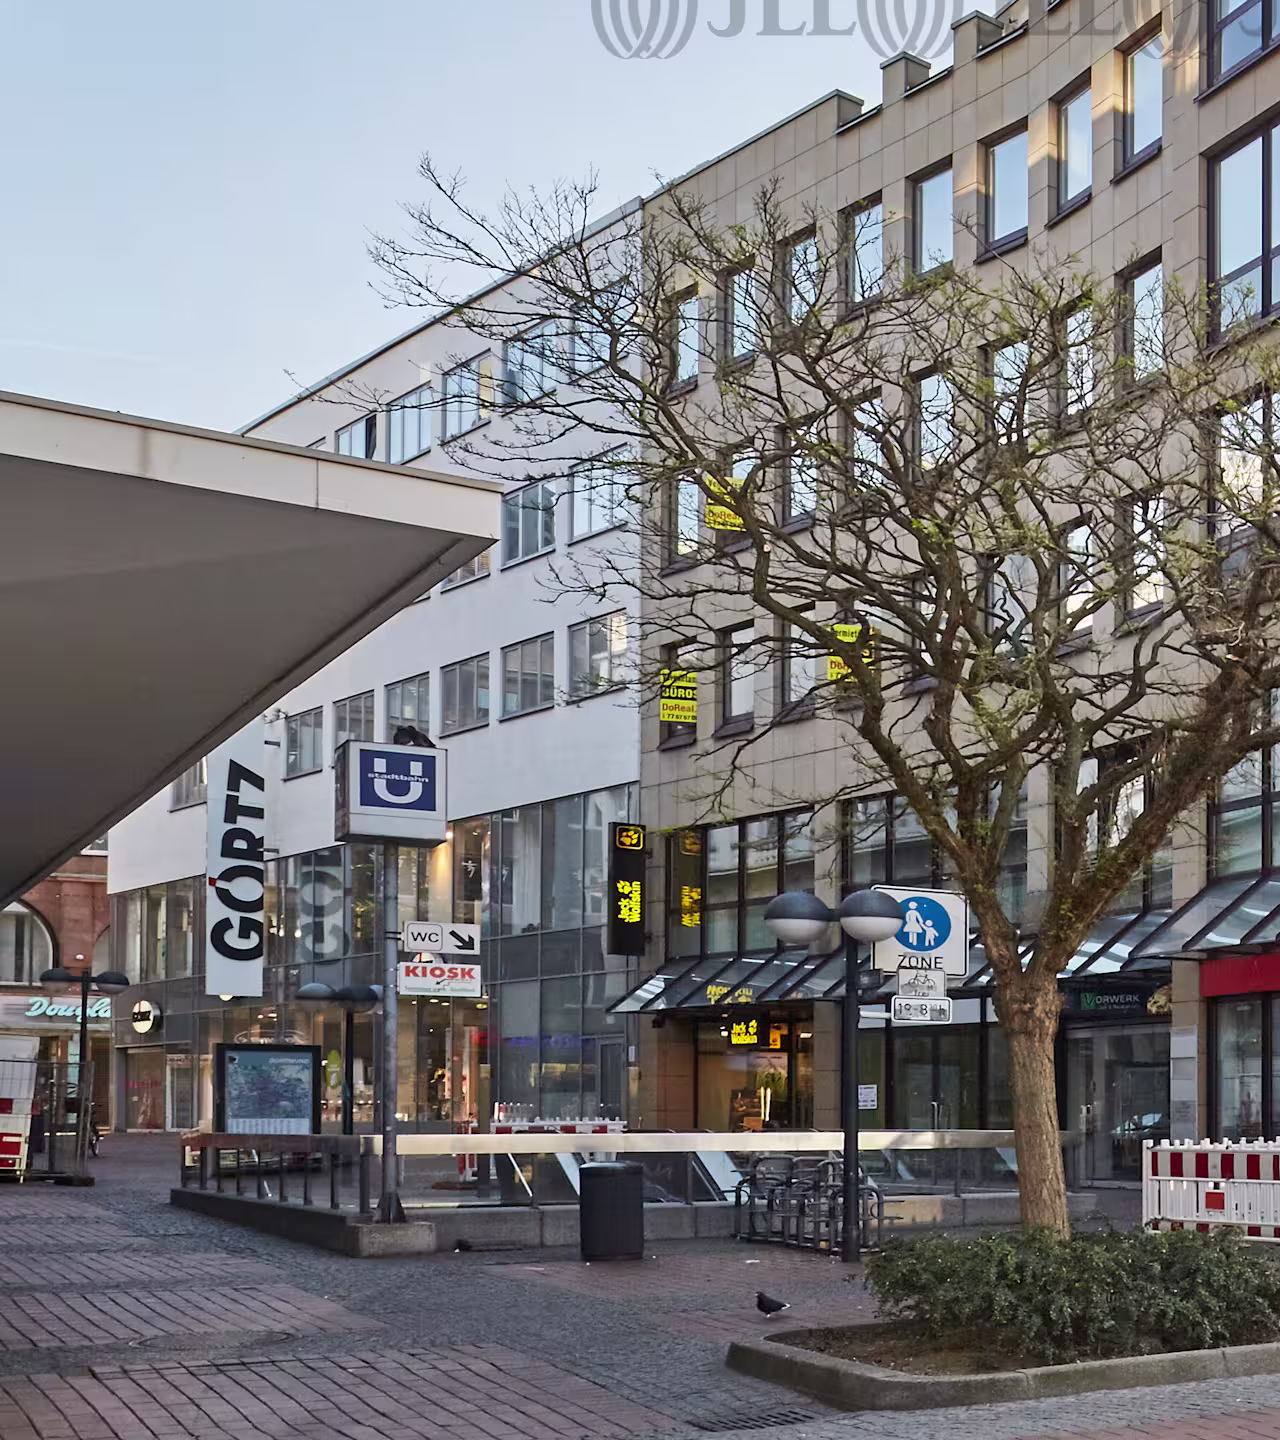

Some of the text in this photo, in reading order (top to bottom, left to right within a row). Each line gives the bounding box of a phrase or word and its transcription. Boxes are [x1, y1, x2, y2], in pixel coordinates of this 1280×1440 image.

[368, 772, 429, 783] stadtbahn
[628, 881, 641, 922] Wolfskin
[618, 898, 630, 922] Jack
[411, 931, 439, 943] WC
[898, 954, 943, 970] ZONE
[404, 965, 475, 979] KIOSK
[1084, 993, 1139, 1006] VORWERK
